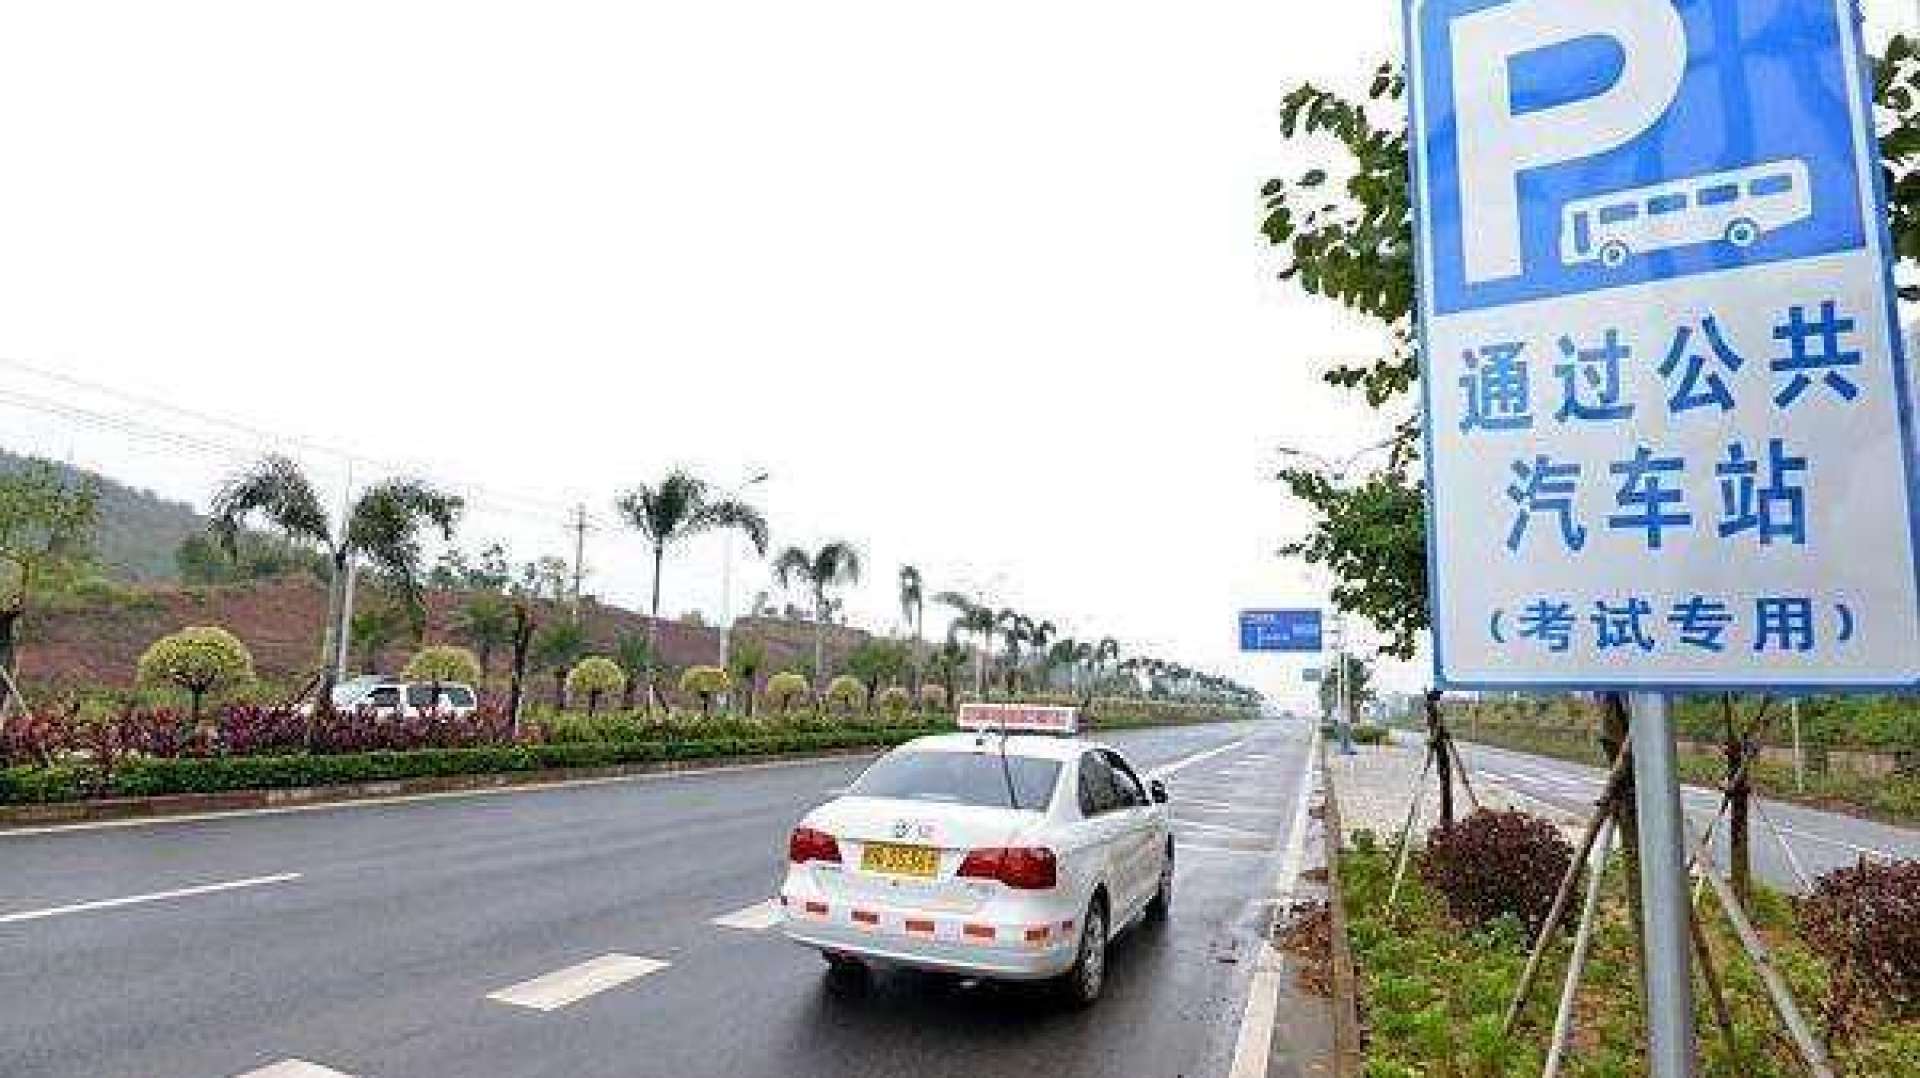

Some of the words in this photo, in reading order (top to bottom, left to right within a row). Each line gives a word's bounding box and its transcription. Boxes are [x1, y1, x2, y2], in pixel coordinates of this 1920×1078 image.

[1449, 0, 1688, 283] P
[1458, 300, 1862, 432] 通过公共
[1505, 438, 1808, 553] 汽车站
